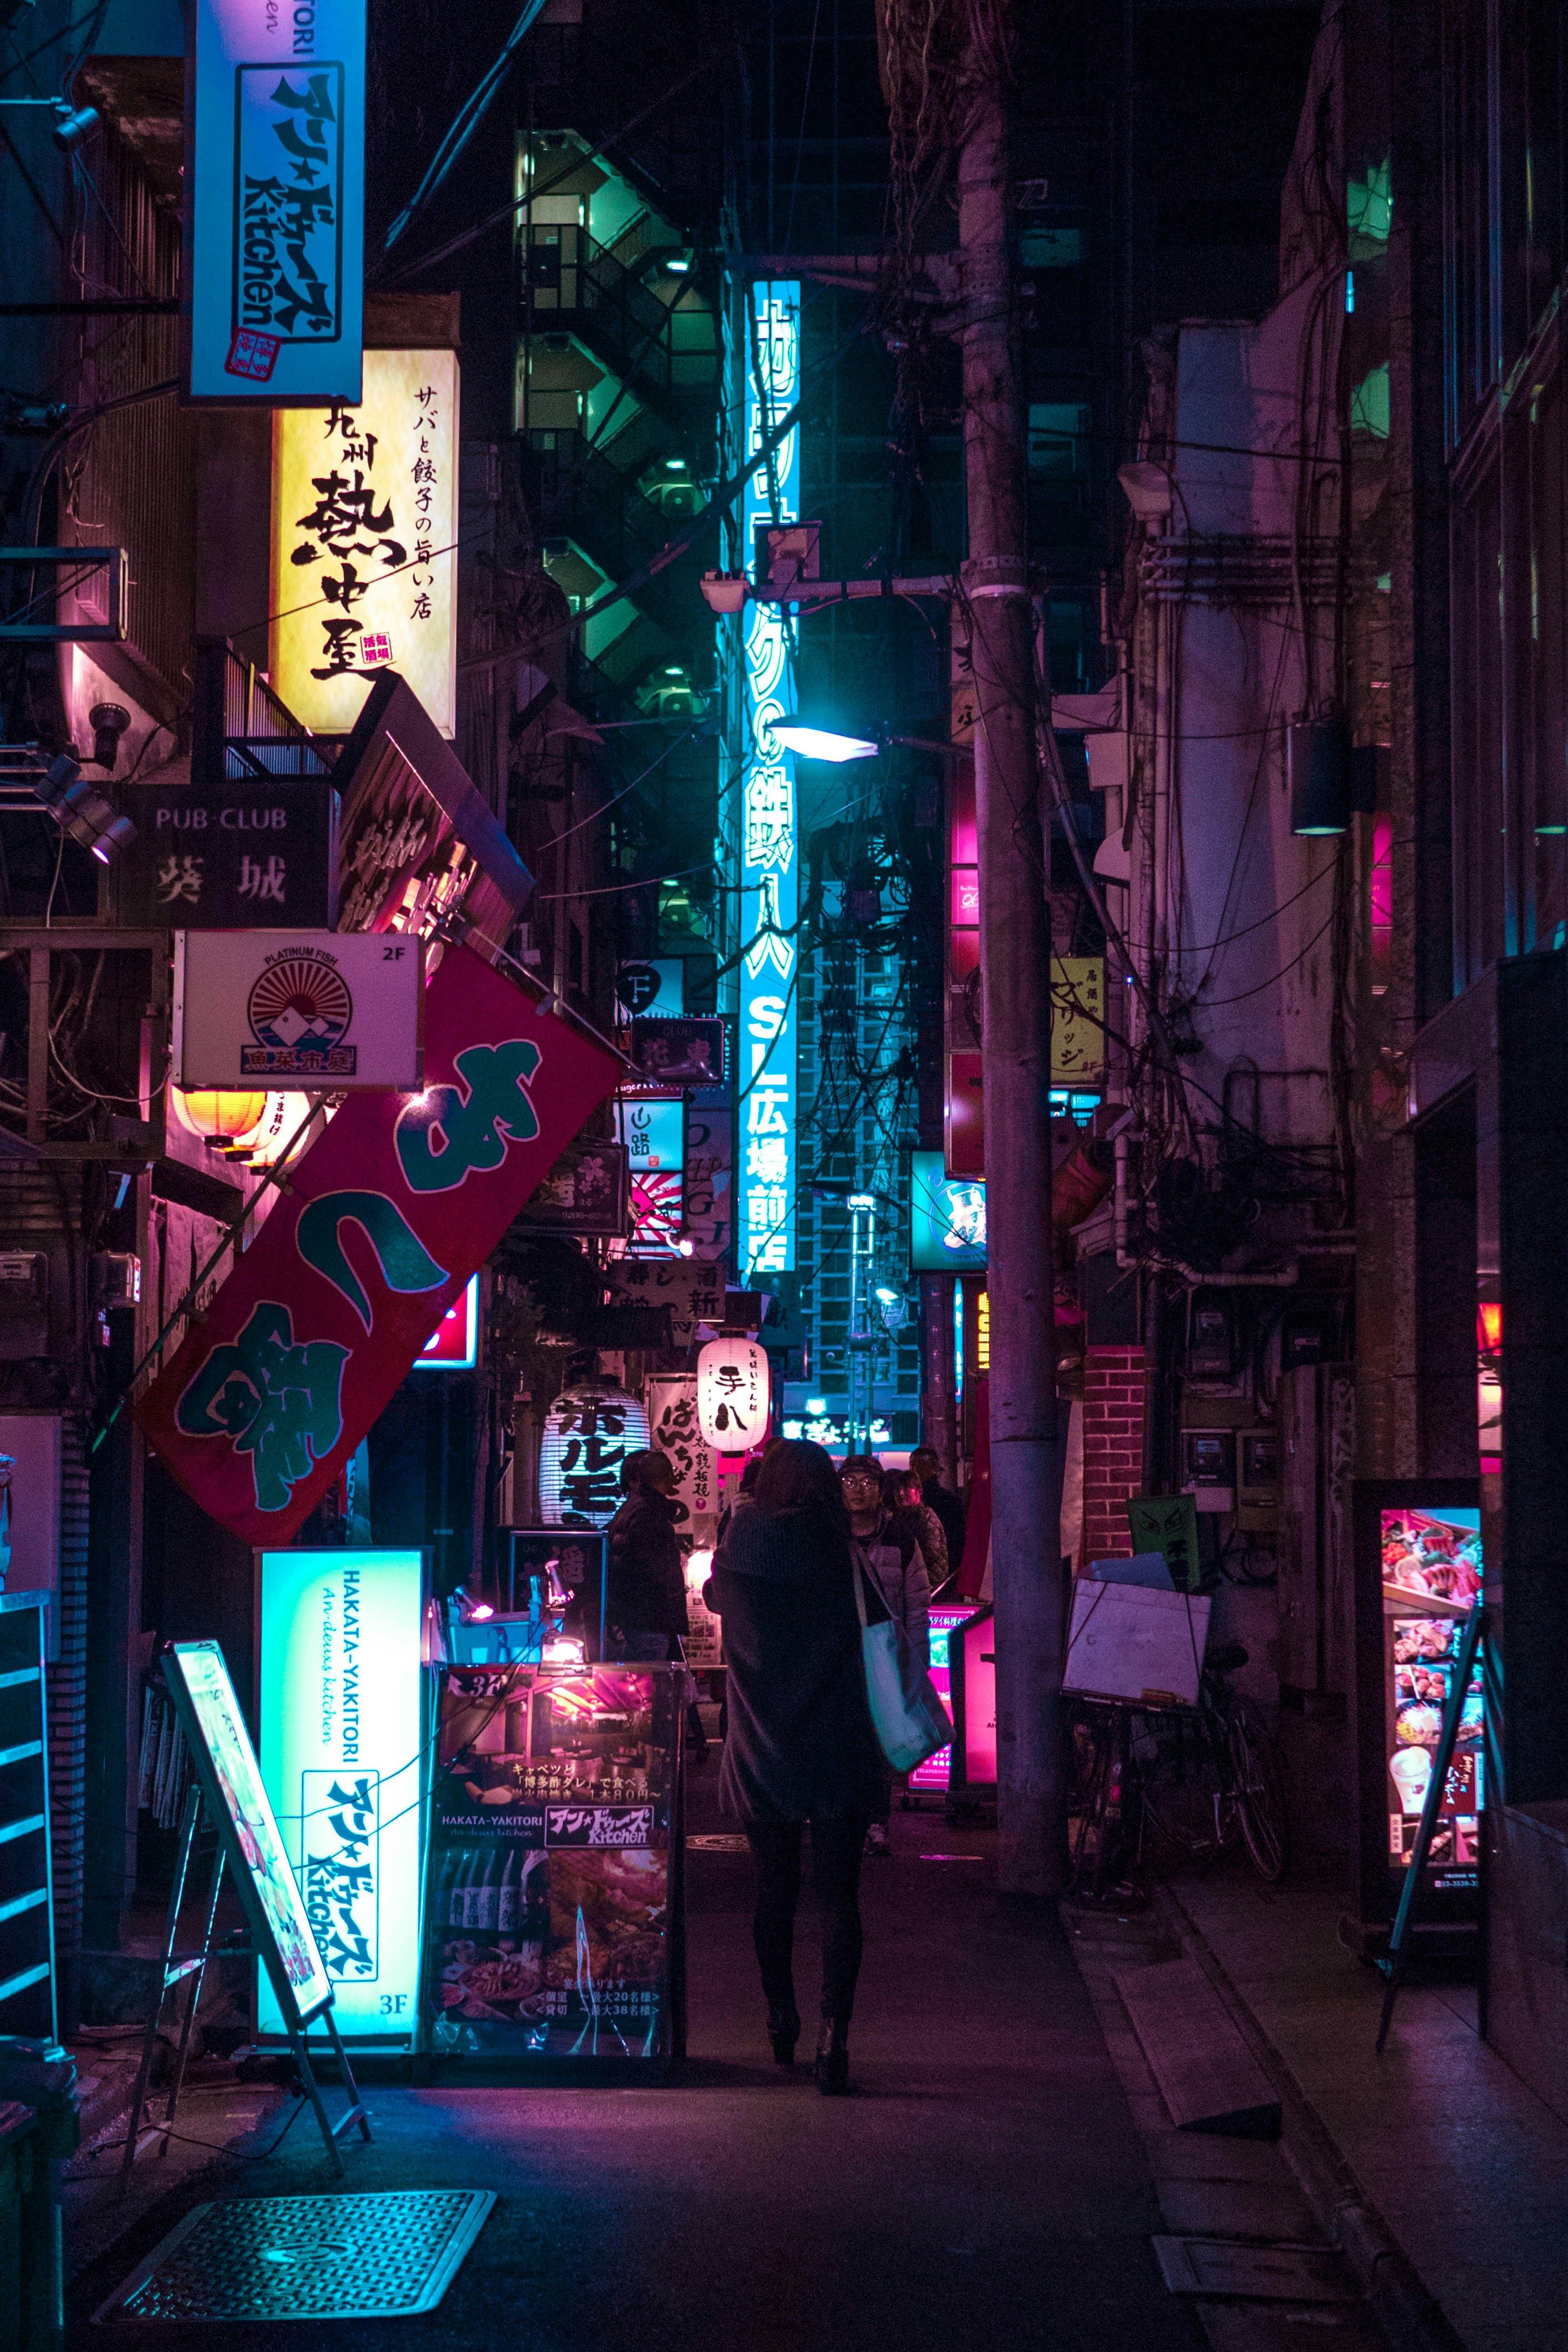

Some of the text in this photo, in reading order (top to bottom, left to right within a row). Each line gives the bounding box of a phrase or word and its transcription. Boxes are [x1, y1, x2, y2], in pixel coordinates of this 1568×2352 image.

[243, 175, 282, 326] Kitchen
[410, 386, 437, 621] サバと餃子の旨い店
[156, 807, 287, 830] PUB CLUB
[264, 947, 339, 966] PLATINUM FISH
[383, 947, 406, 961] 2F
[342, 1570, 360, 1762] HAKATA-YAKITORI
[513, 1764, 573, 1775] キャベツと
[442, 1815, 543, 1826] HAKATA-YAKITORI
[379, 1994, 408, 2015] 3F
